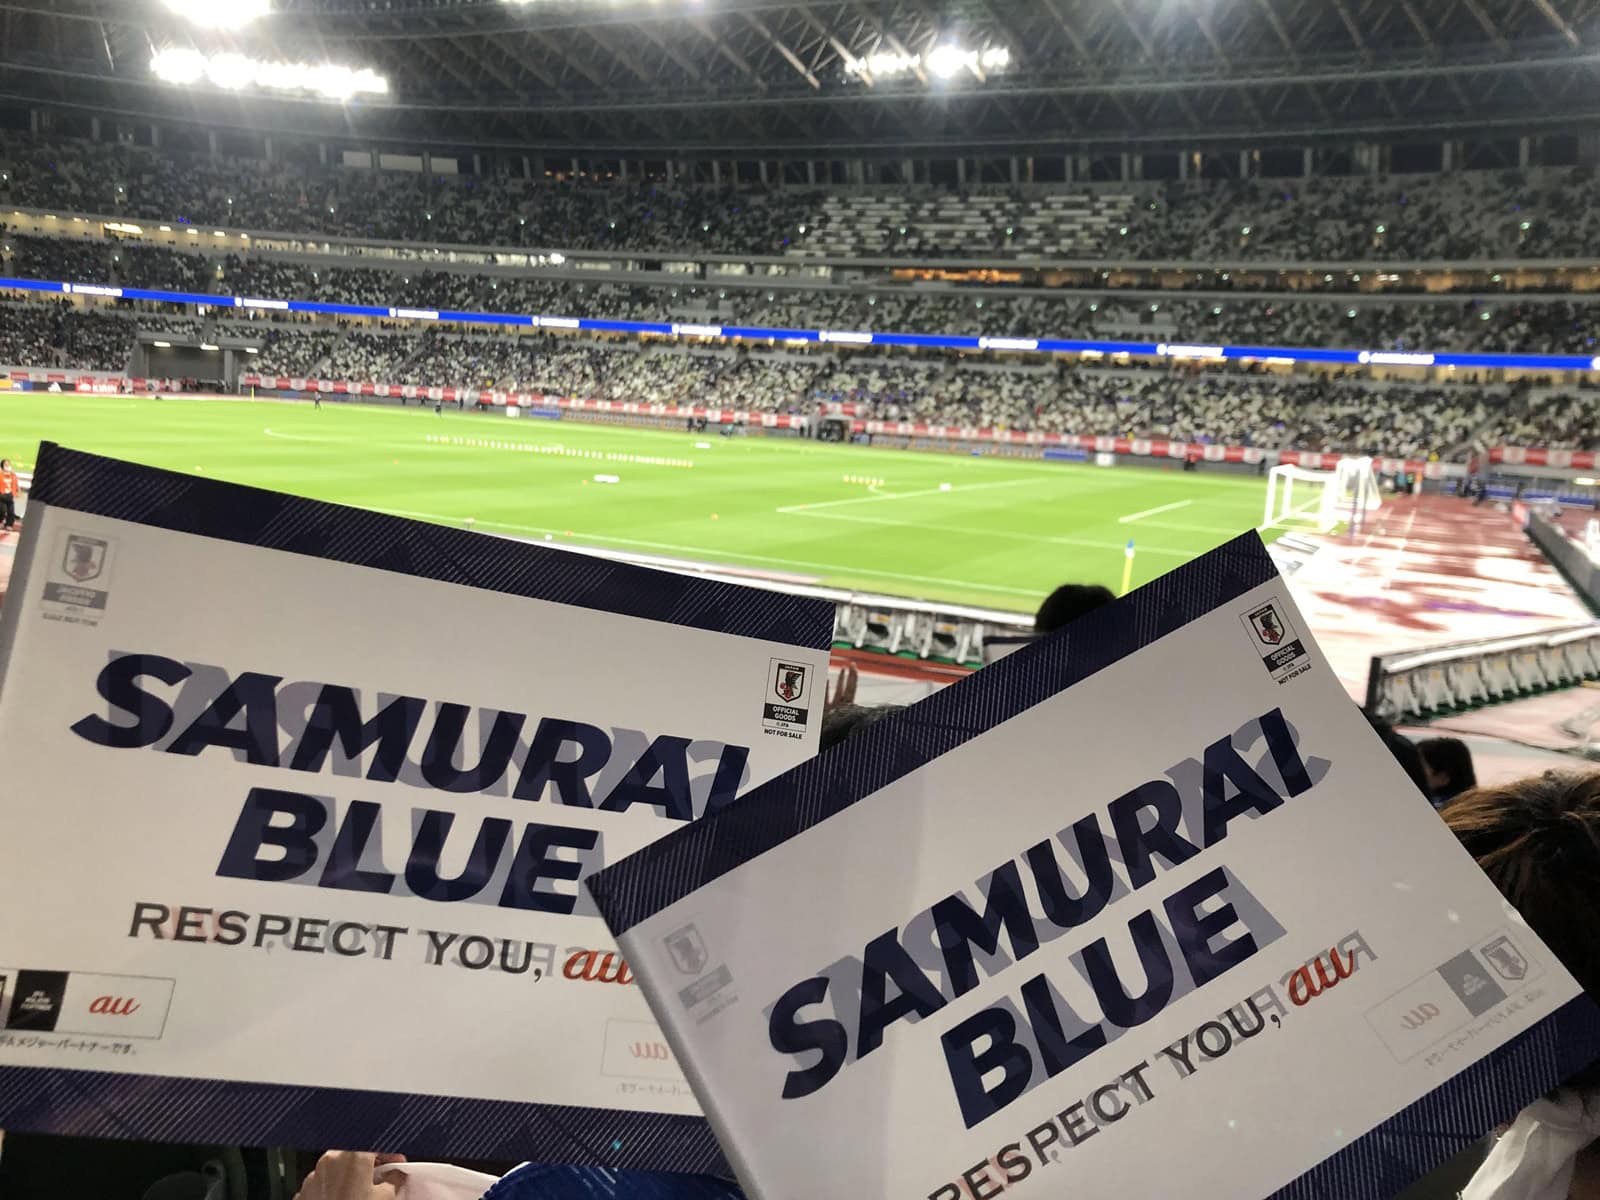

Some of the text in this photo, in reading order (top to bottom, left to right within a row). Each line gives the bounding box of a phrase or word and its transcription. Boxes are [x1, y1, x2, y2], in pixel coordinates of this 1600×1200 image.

[70, 653, 750, 822] SAMURAI
[764, 728, 776, 736] NOT
[788, 732, 802, 740] SALE
[772, 705, 800, 715] OFFICIAL
[774, 713, 796, 722] GOODS
[215, 787, 599, 914] BLUE
[768, 706, 1313, 1100] SAMURAI
[128, 902, 634, 985] RESPECT YOU, au
[88, 995, 142, 1016] au
[940, 865, 1259, 1130] BLUE
[1161, 996, 1281, 1076] YOU,
[1289, 946, 1354, 1006] au
